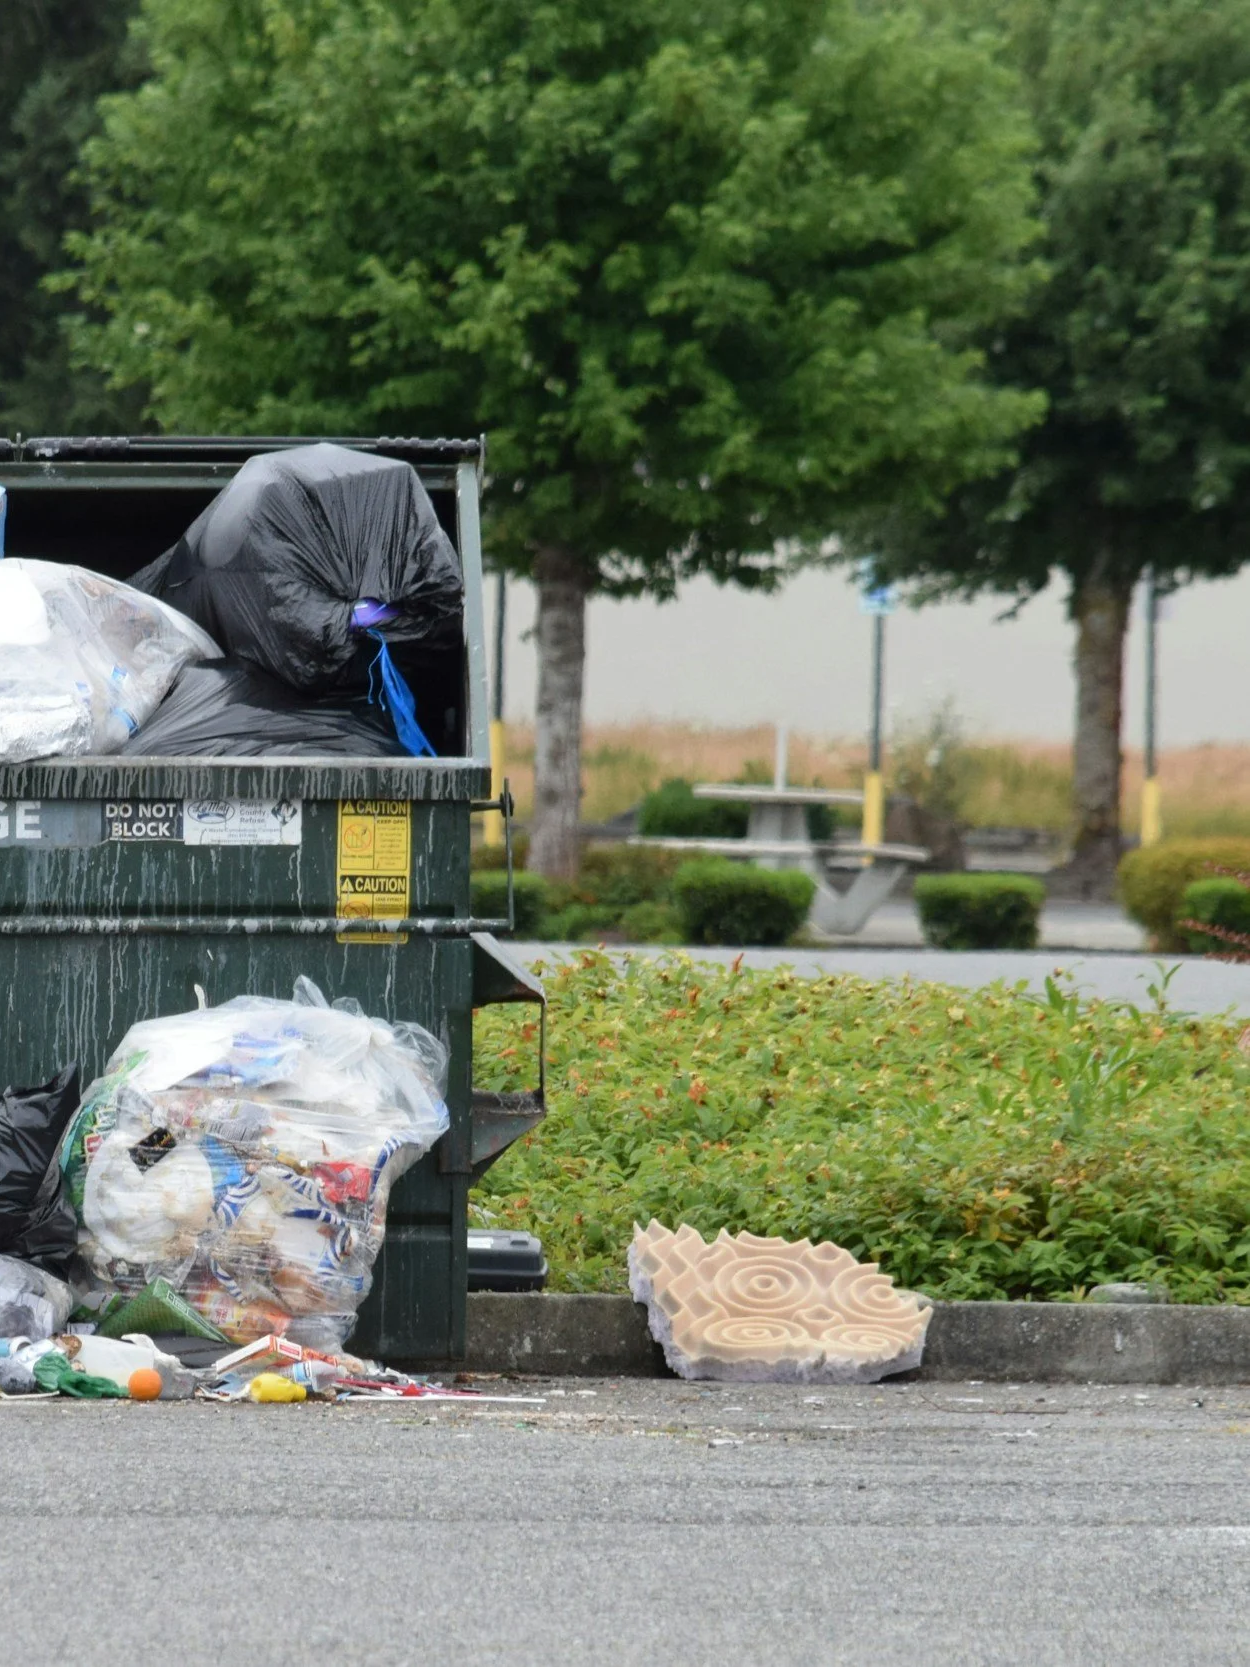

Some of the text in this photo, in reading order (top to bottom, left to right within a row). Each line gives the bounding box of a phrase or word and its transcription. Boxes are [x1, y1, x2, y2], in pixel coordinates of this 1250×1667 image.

[105, 803, 177, 818] DO NOT
[239, 808, 267, 816] County
[356, 800, 407, 815] CAUTION
[111, 822, 171, 837] BLOCK
[354, 877, 406, 892] CAUTION
